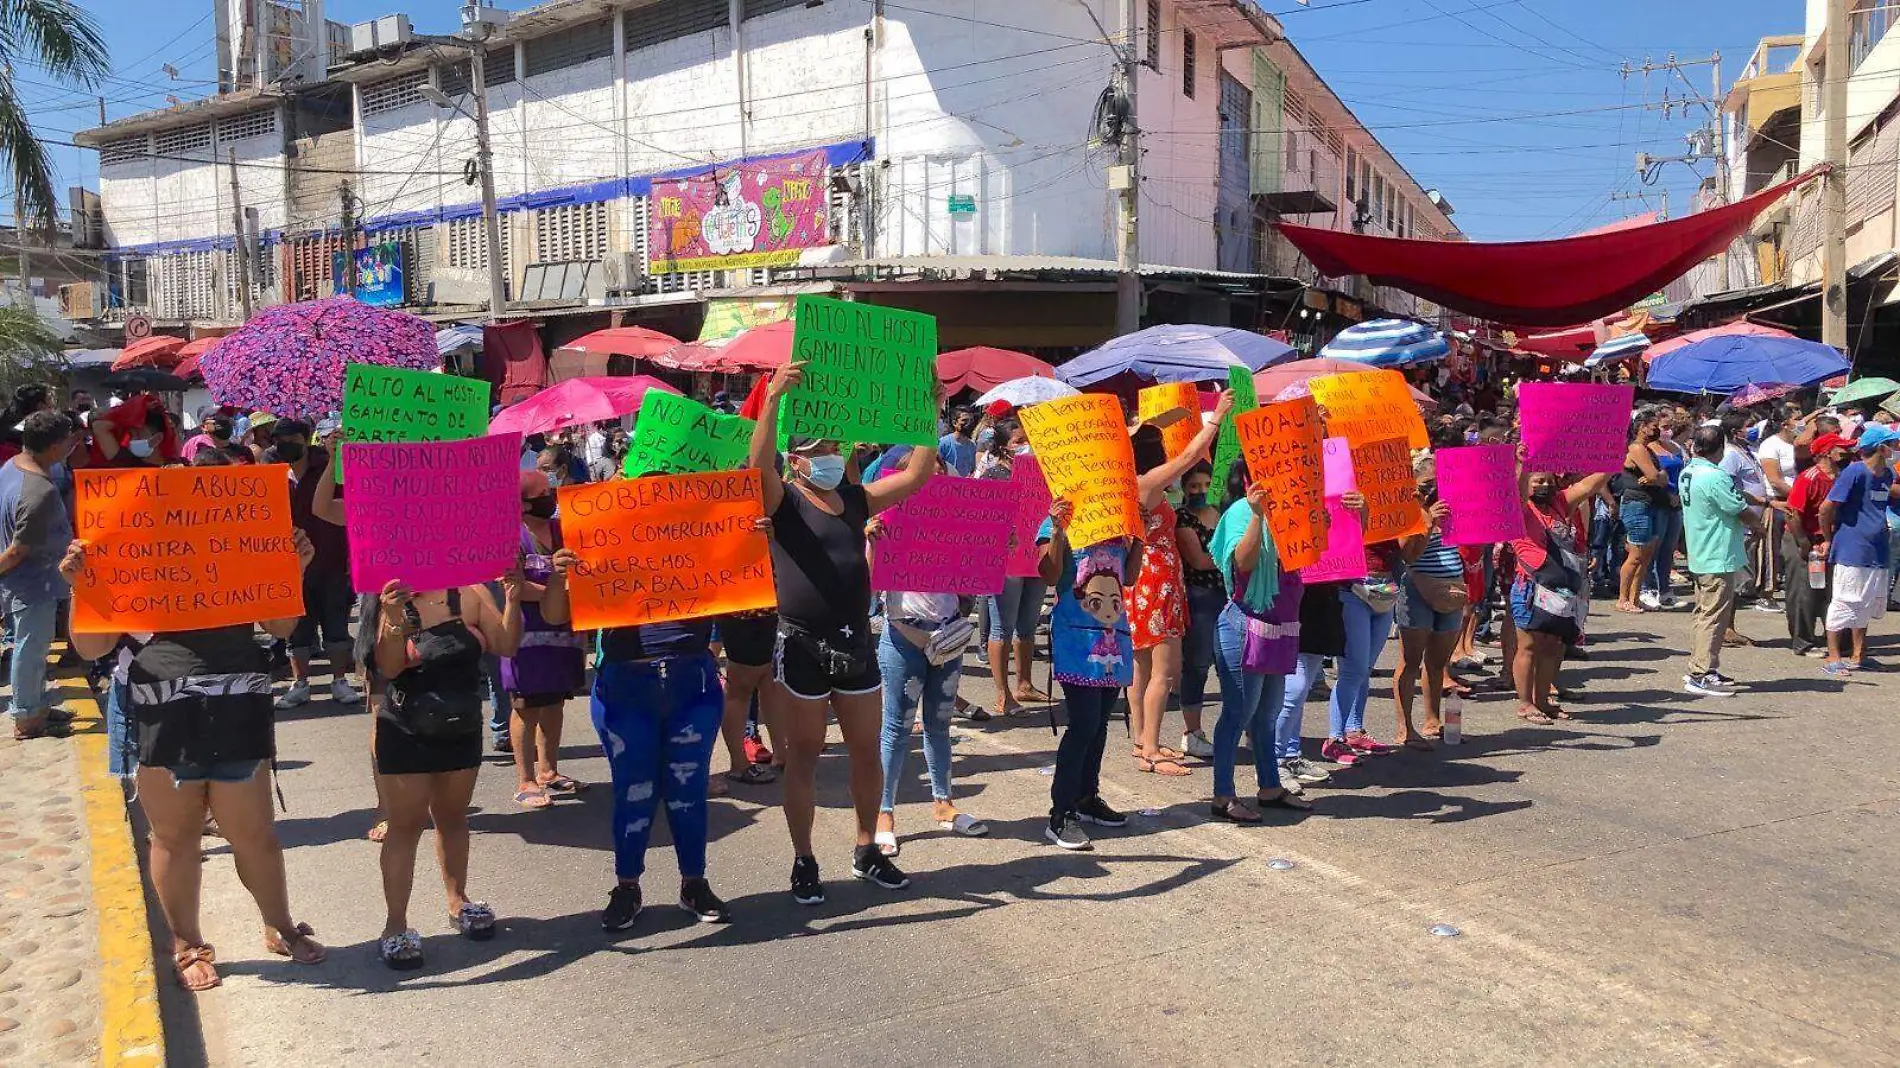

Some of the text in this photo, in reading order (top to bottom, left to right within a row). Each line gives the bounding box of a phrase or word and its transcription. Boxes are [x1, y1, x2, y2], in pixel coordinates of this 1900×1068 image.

[803, 301, 849, 334] ALTO
[855, 310, 879, 341] AL
[798, 337, 888, 376] GAMIENTO
[896, 352, 906, 379] Y
[351, 373, 405, 397] ALTO
[413, 387, 437, 404] AL
[797, 370, 860, 400] ABUSO
[870, 381, 890, 408] DE
[349, 405, 466, 429] GAMIENTO DE
[651, 399, 685, 427] NO
[691, 414, 723, 440] AL
[792, 398, 851, 422] ENTOS
[859, 407, 881, 429] DE
[794, 419, 844, 439] DAD
[1244, 416, 1274, 441] NO
[348, 446, 459, 470] PRESIDENTA
[643, 429, 719, 471] SEXUAL
[1249, 439, 1308, 463] SEXUAL
[83, 474, 268, 500] NO AL ABUSO
[393, 475, 474, 497] MUJERES
[570, 474, 760, 516] GOBERNADORA:
[1680, 472, 1693, 507] 3
[83, 502, 271, 529] DE LOS MILITARES
[1274, 517, 1300, 535] LA
[579, 515, 758, 549] LOS COMERCIANTES
[913, 526, 999, 548] INSEGURIDAD
[118, 539, 196, 558] CONTRA
[209, 537, 231, 554] DE
[239, 535, 297, 554] MUJERES
[412, 550, 436, 567] DE
[574, 554, 696, 577] QUEREMOS
[883, 551, 1005, 568] DE PARTE DE LOS
[106, 564, 200, 586] JOVENES,
[594, 564, 764, 598] TRABAJAR EN
[893, 571, 990, 590] MILITARES
